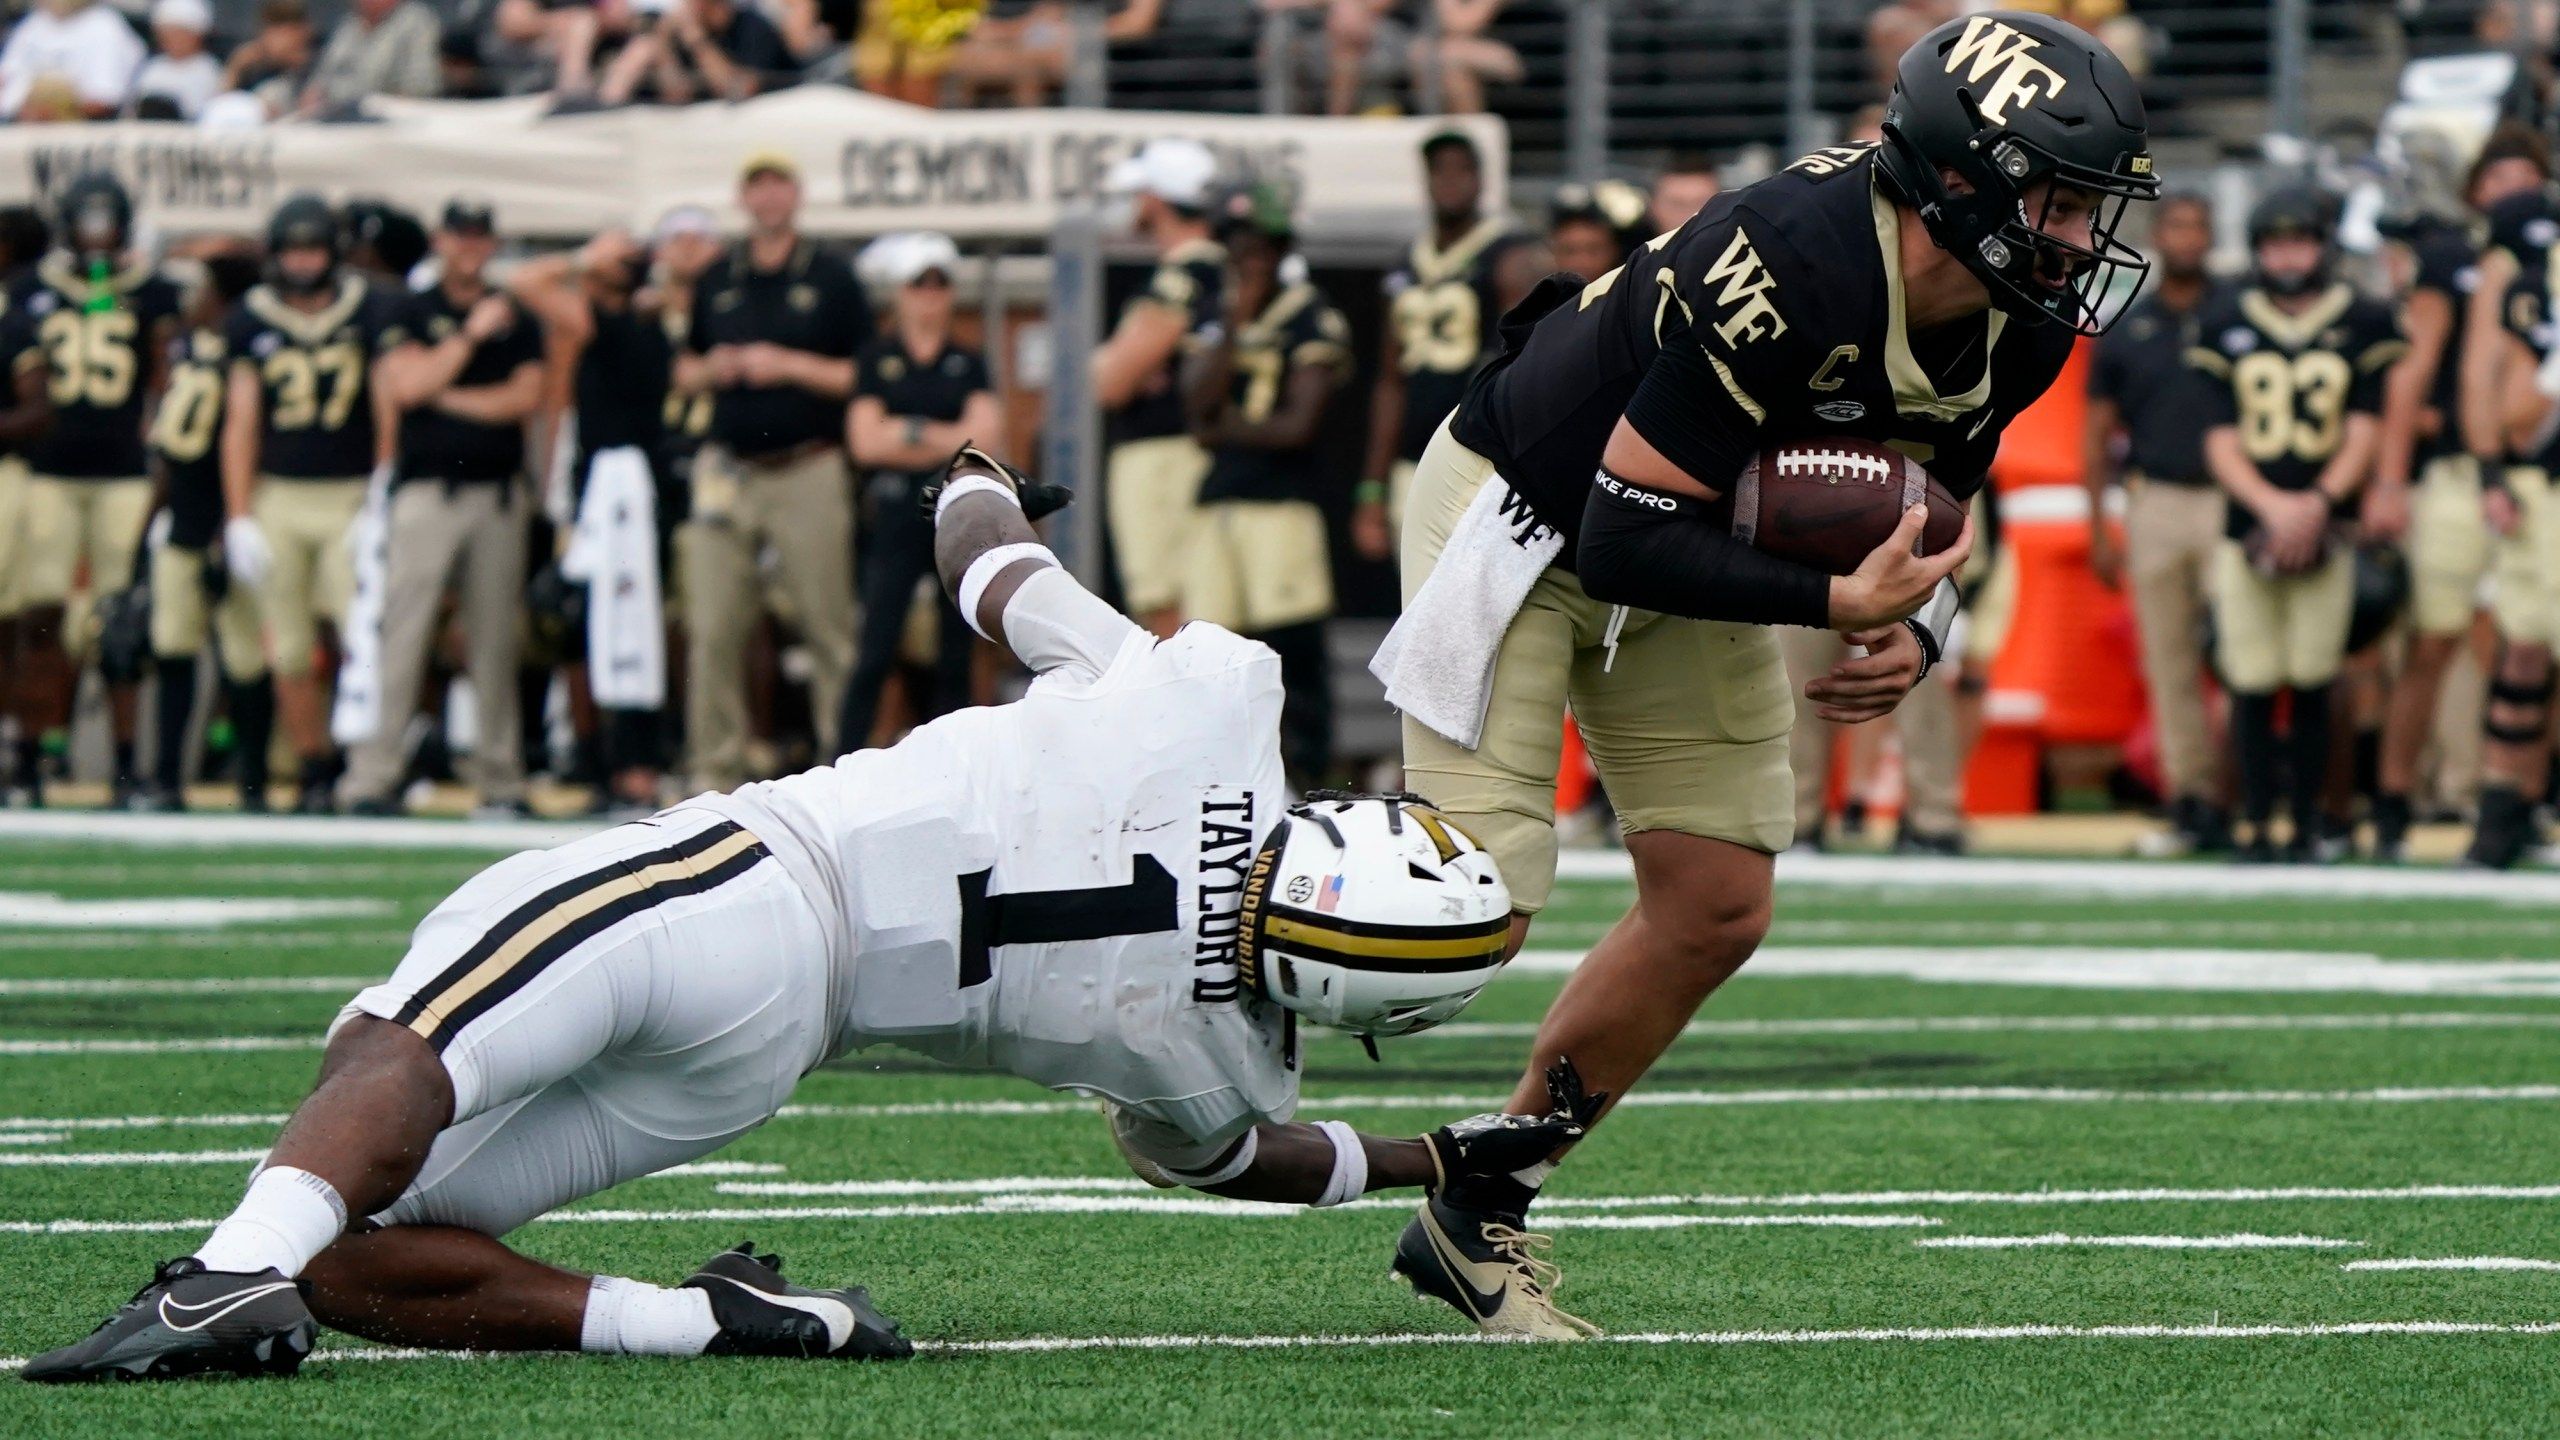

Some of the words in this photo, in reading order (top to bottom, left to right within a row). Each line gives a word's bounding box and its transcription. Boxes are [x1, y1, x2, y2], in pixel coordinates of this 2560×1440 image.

[1944, 16, 2067, 126] WF
[842, 137, 1031, 206] DEMON
[1703, 226, 1788, 351] WF
[39, 308, 139, 408] 35
[262, 348, 366, 432] 37
[1808, 344, 1860, 391] C
[2234, 350, 2352, 463] 83
[1814, 403, 1864, 420] ACC
[1499, 484, 1558, 550] WF
[1622, 487, 1677, 511] PRO
[957, 853, 1179, 990] 1
[1195, 791, 1254, 967] TAYLOR
[1238, 849, 1277, 987] VANDERBILT
